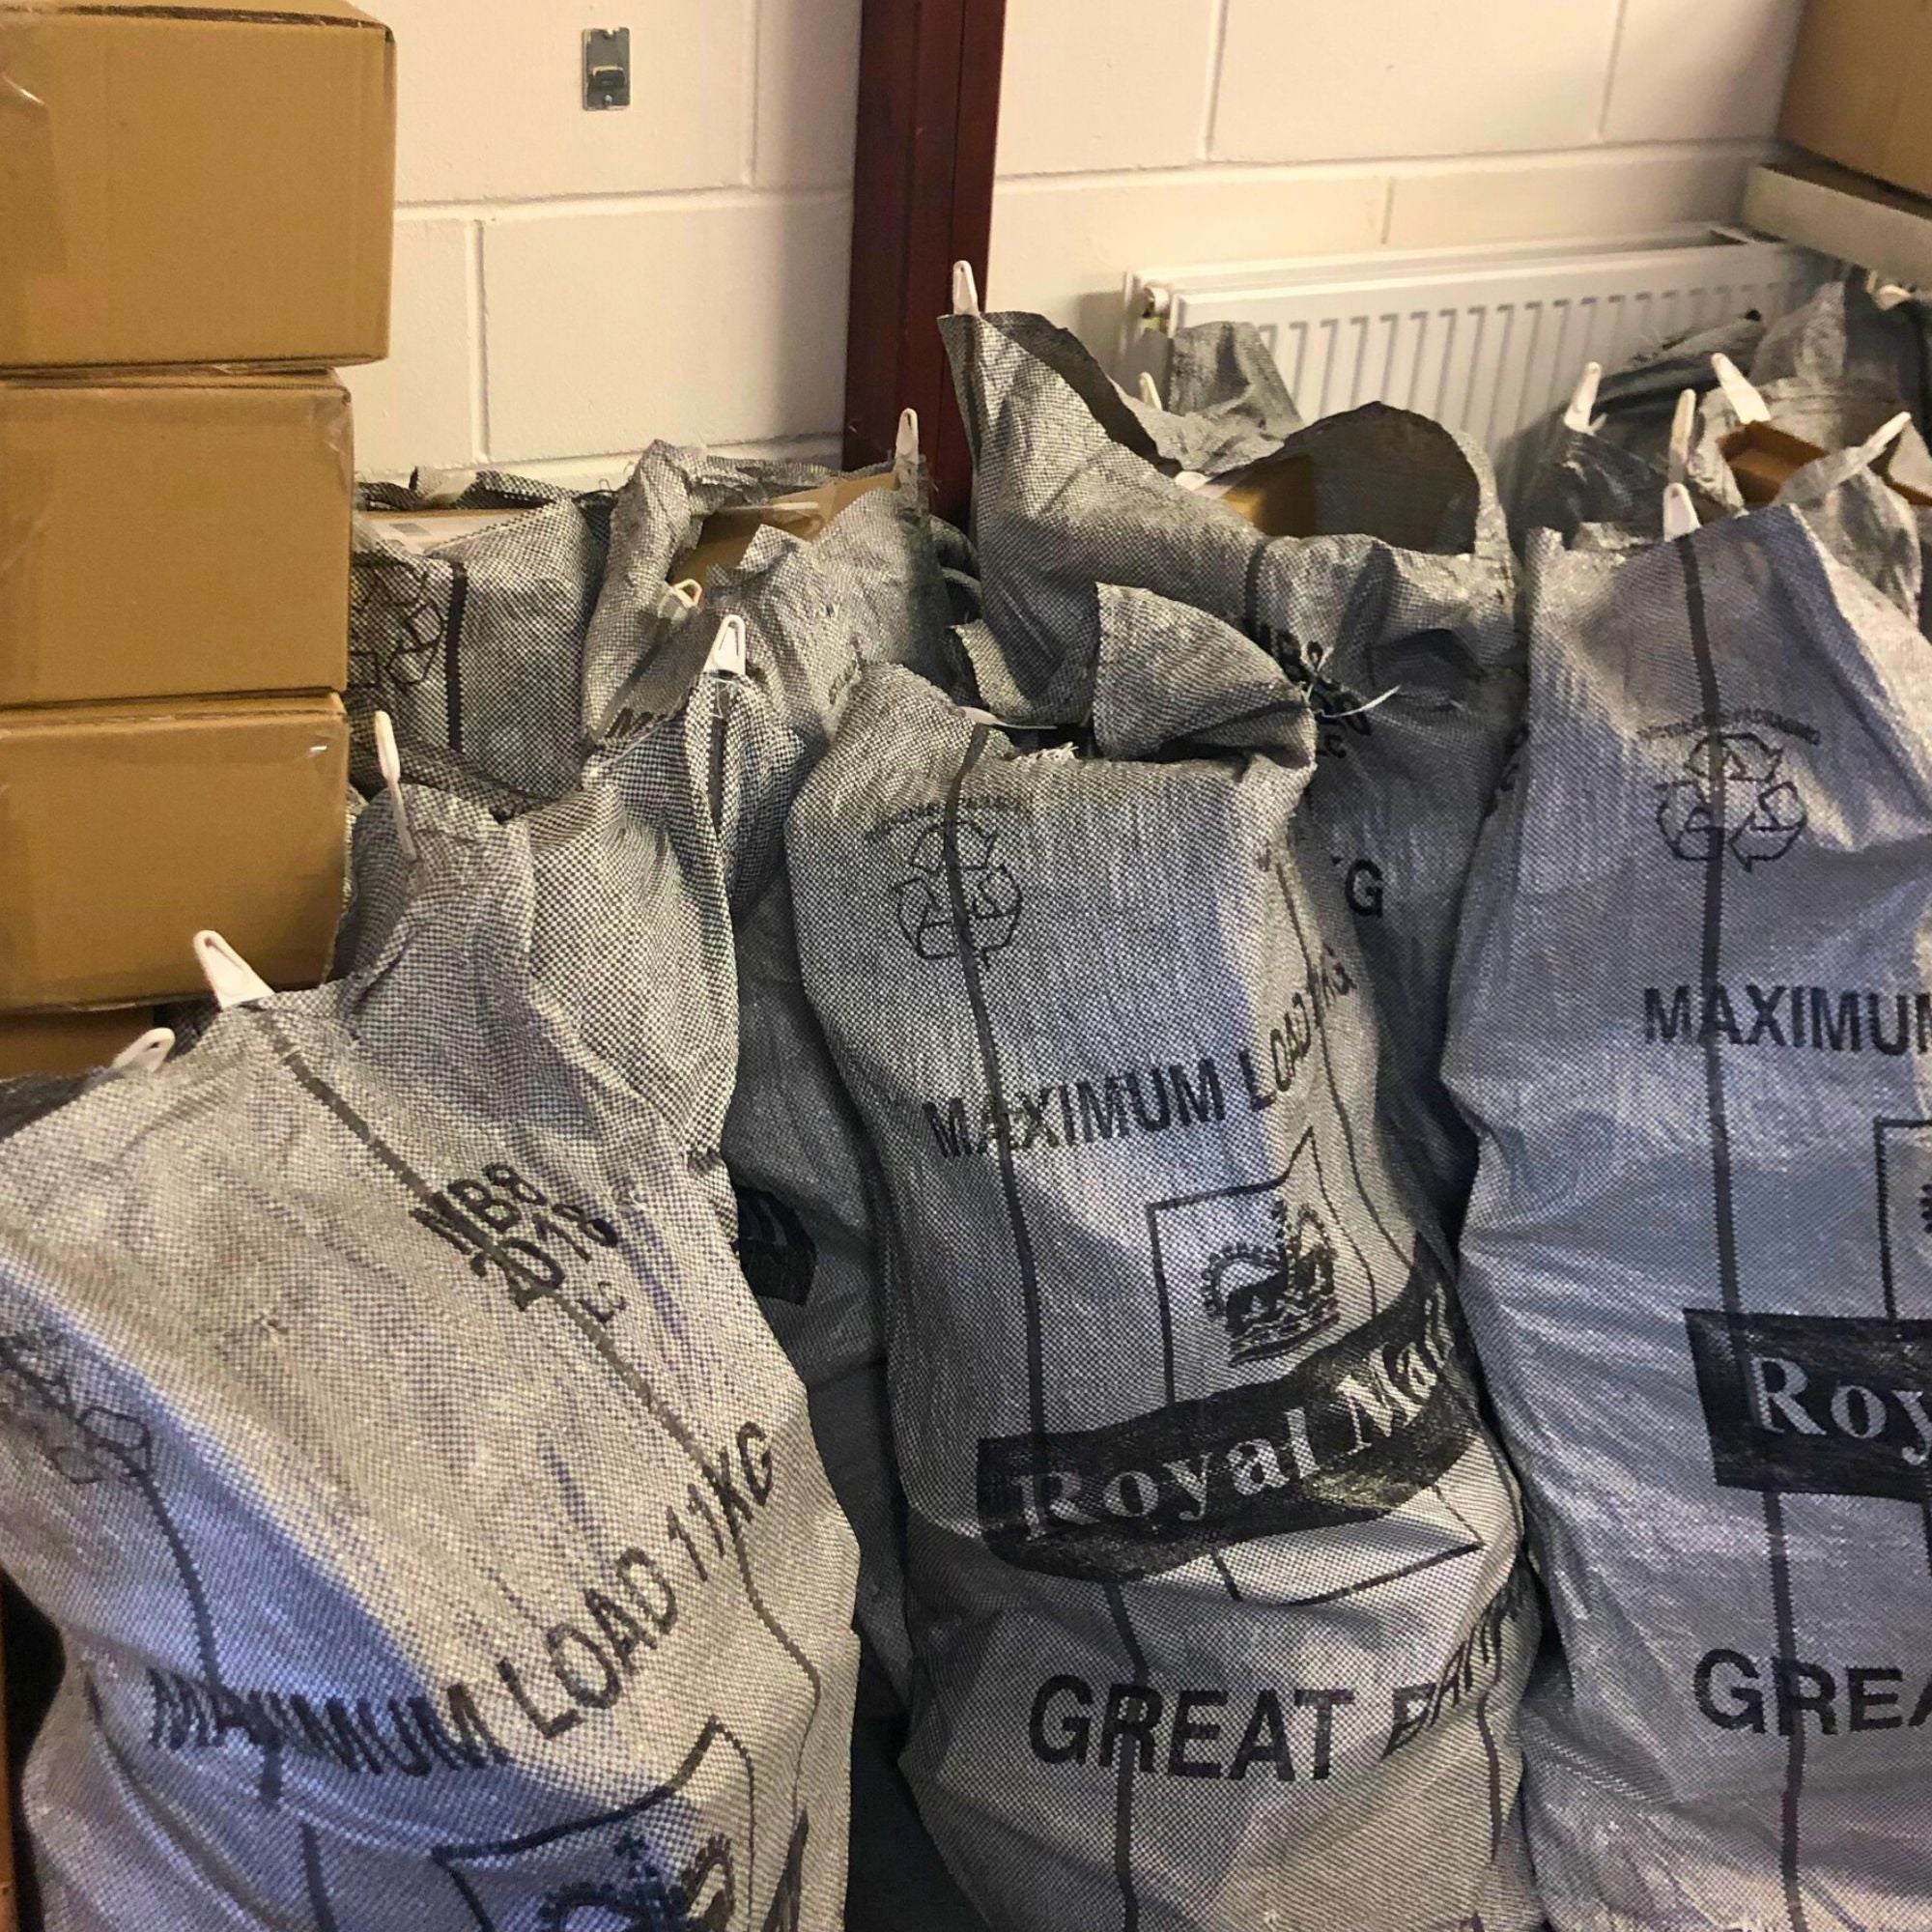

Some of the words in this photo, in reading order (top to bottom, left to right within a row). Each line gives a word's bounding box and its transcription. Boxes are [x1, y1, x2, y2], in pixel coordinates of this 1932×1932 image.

[1014, 1406, 1321, 1543] Royal
[497, 1548, 676, 1739] LOAD
[667, 1420, 773, 1582] 11KG
[1028, 1673, 1354, 1782] GREAT
